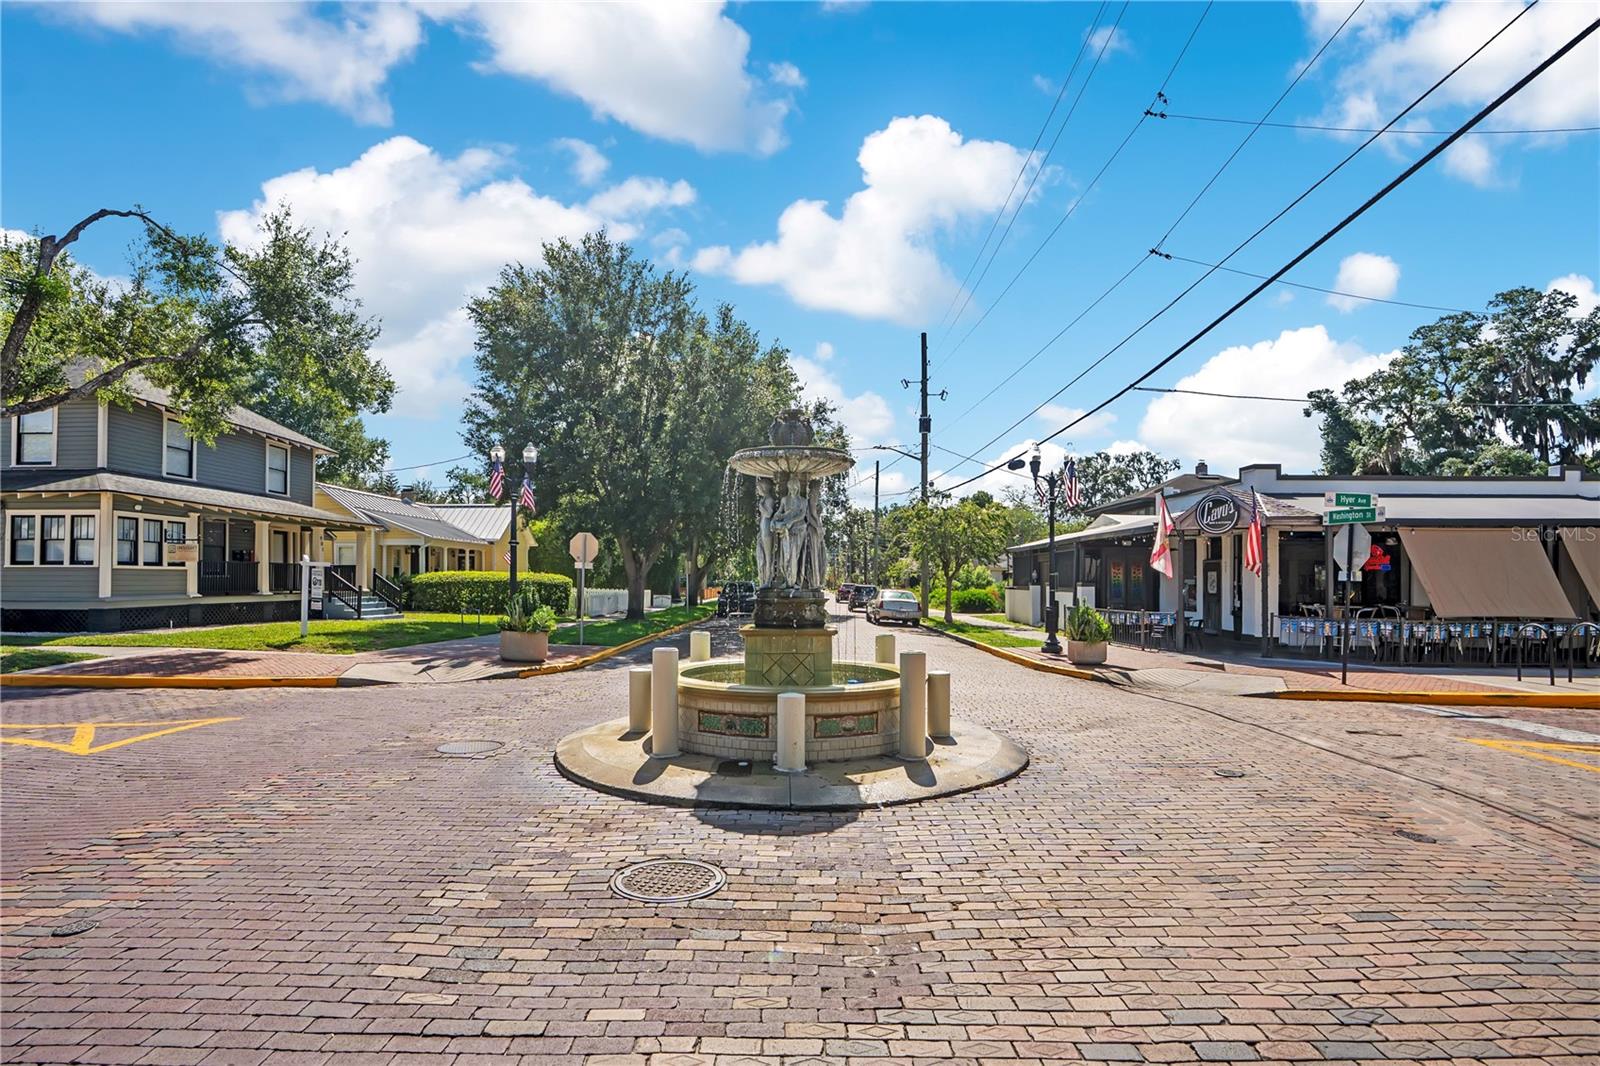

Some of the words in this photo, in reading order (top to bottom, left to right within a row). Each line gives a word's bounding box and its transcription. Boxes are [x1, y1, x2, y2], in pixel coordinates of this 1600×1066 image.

[1340, 495, 1355, 504] Hyer
[1204, 501, 1235, 524] Cavo's
[1332, 511, 1364, 520] Washington
